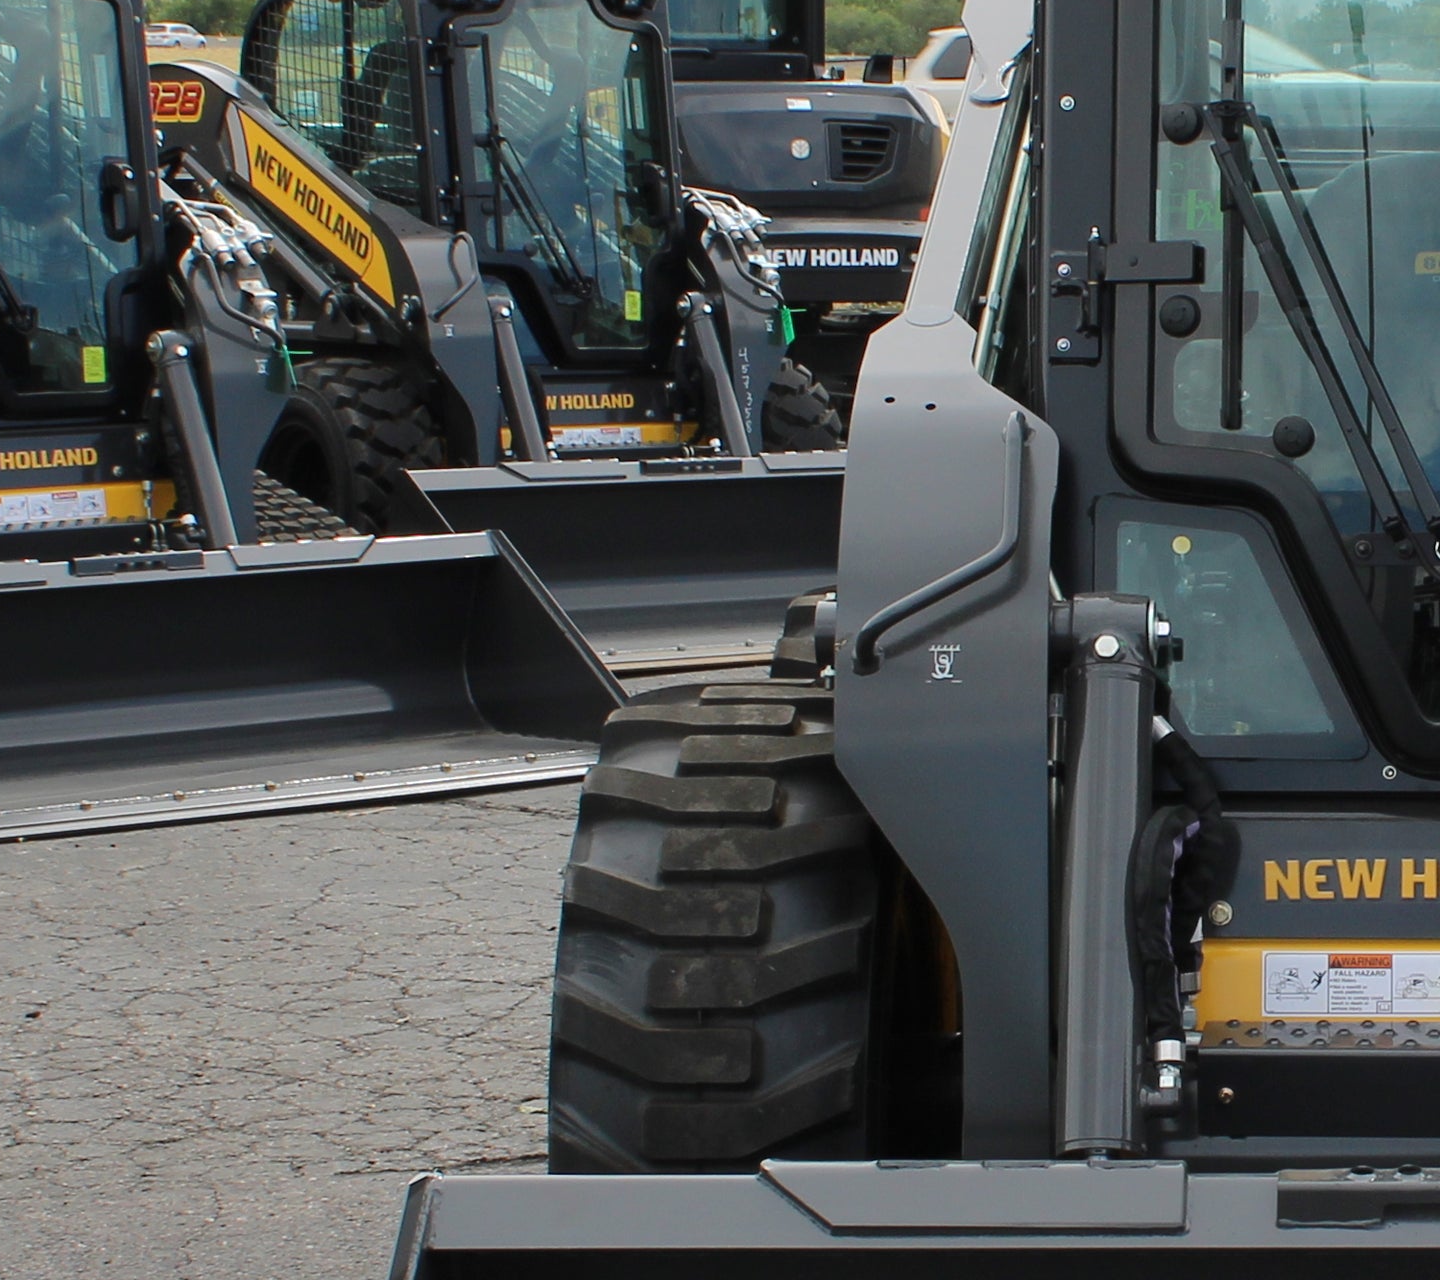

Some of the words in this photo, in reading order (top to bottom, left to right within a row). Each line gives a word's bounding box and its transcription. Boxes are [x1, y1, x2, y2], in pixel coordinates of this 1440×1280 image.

[254, 145, 294, 193] NEW
[294, 176, 369, 260] HOLLAND
[810, 248, 899, 267] HOLLAND
[561, 393, 635, 411] HOLLAND
[0, 446, 98, 470] HOLLAND
[1263, 857, 1387, 901] NEW
[1341, 956, 1391, 967] WARNING
